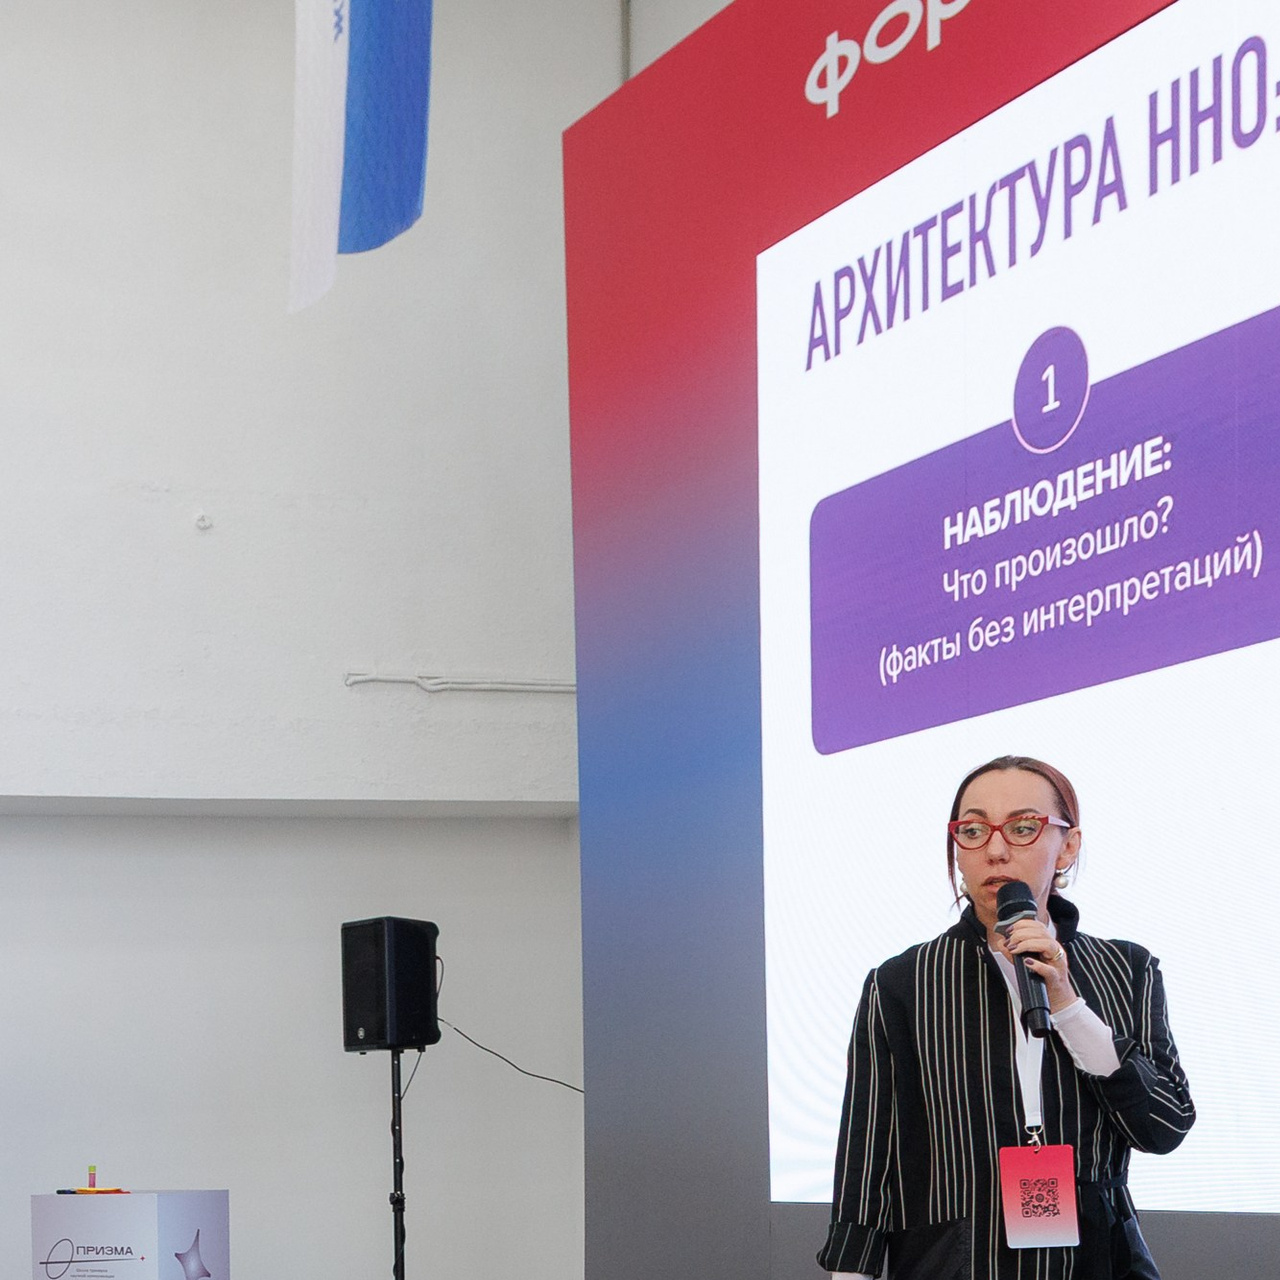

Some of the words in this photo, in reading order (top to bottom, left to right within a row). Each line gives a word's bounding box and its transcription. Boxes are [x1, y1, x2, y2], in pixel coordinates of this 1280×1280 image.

[805, 115, 1127, 372] АРХИТЕКТУРА
[1041, 364, 1061, 413] 1
[943, 436, 1172, 550] НАБЛЮДЕНИЕ:
[943, 567, 987, 602] Что
[995, 496, 1174, 592] произошло?
[879, 630, 961, 686] (факты
[967, 616, 1015, 652] без
[1023, 530, 1264, 637] интерпретаций)
[76, 1246, 133, 1255] ПРИЗМА
